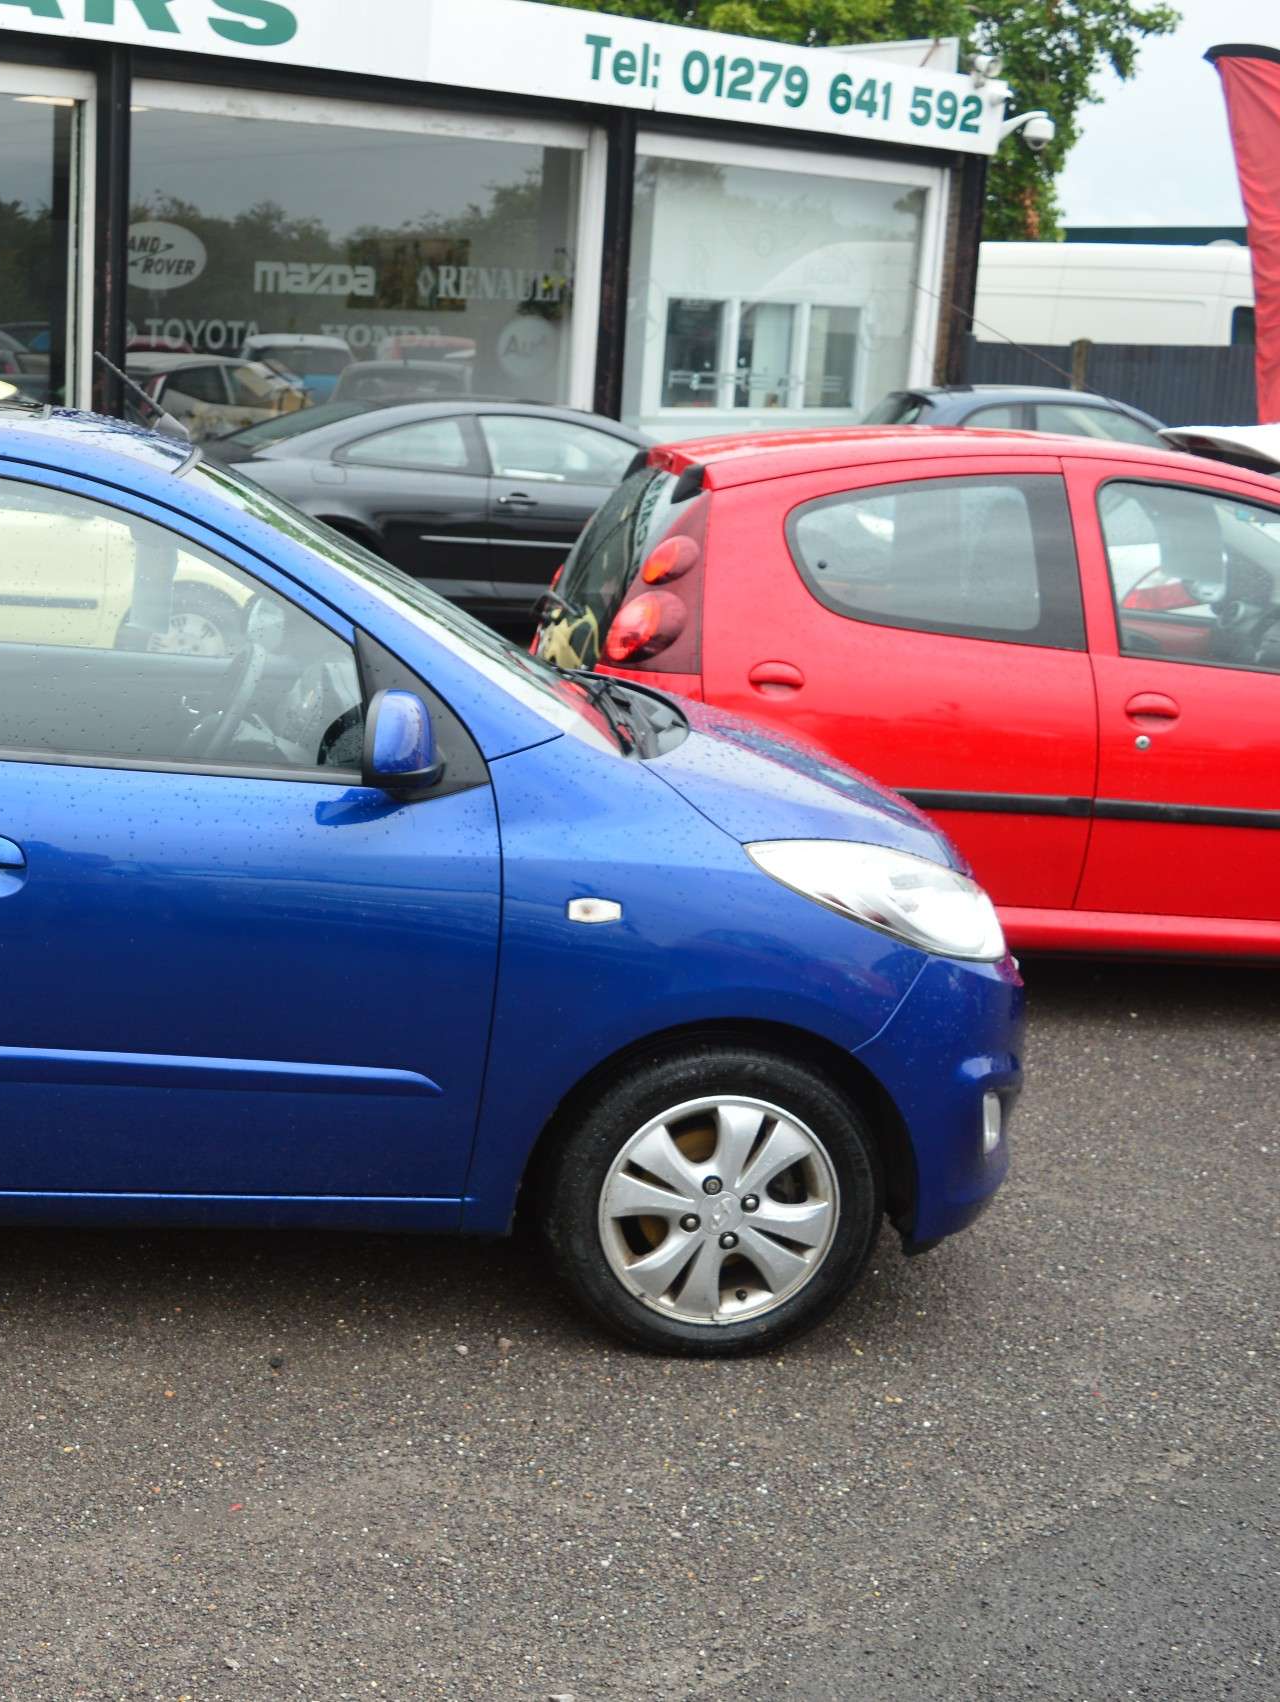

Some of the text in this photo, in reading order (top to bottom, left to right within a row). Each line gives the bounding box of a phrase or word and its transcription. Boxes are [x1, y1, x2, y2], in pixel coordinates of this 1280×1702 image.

[585, 33, 983, 134] Tel: 01279 641 592
[127, 236, 161, 252] AND
[141, 259, 196, 275] ROVER
[145, 318, 260, 349] TOYOTA
